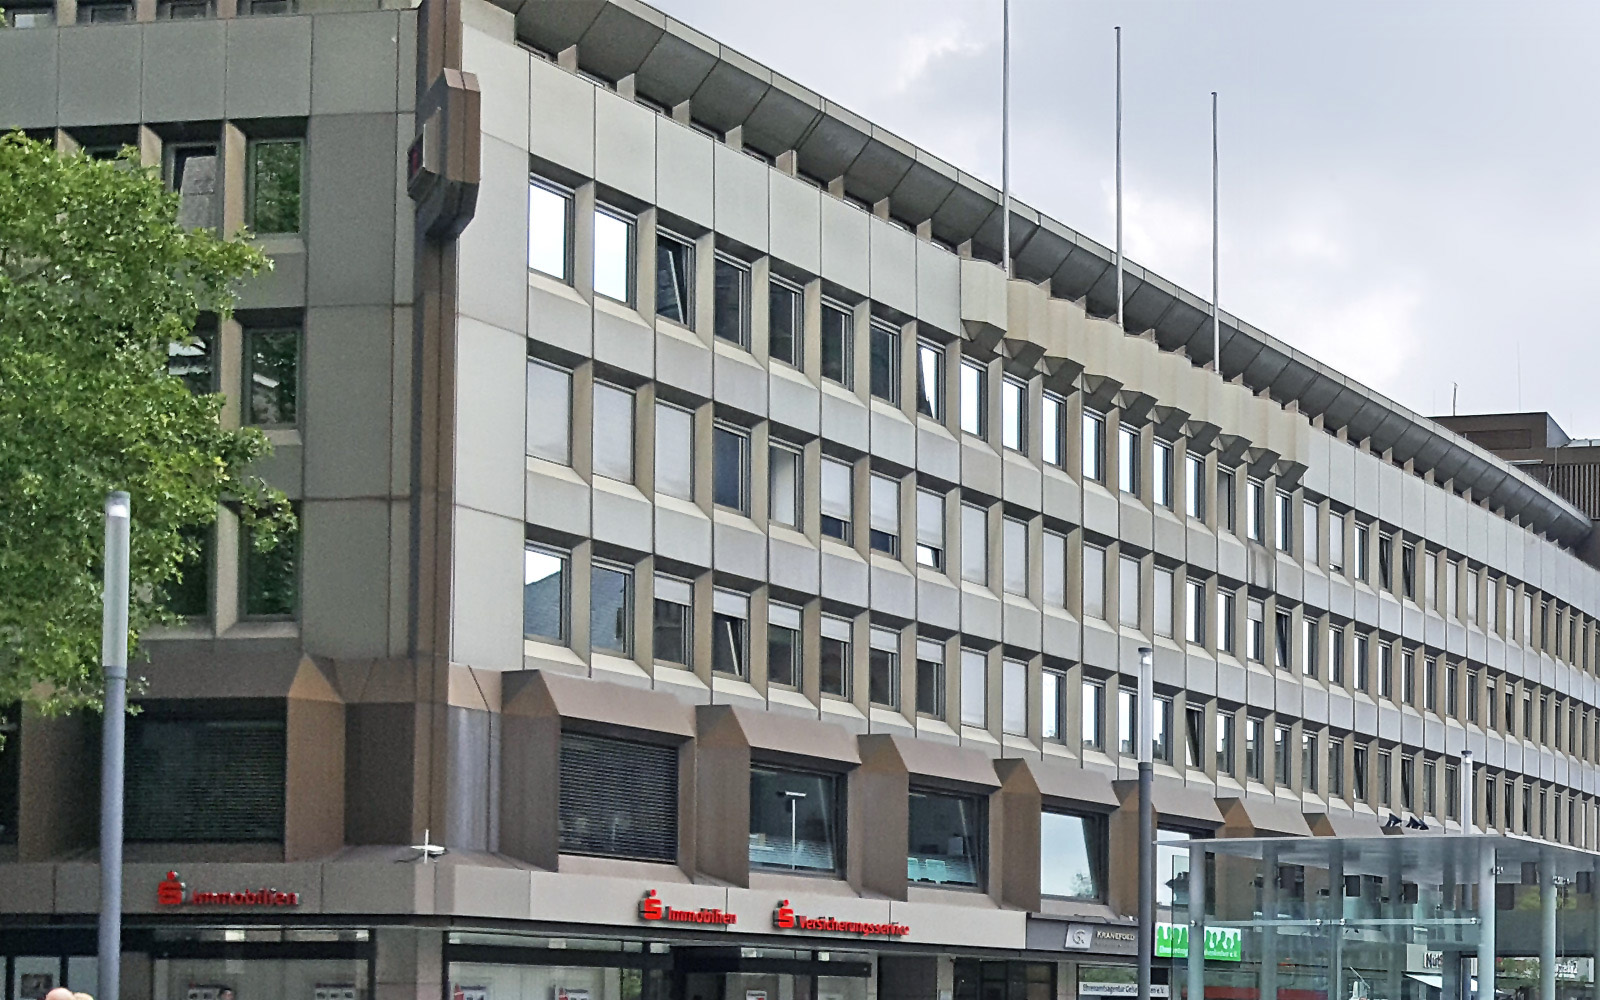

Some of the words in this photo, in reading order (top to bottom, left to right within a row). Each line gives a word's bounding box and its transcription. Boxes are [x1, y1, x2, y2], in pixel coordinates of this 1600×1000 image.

[192, 886, 299, 905] Immobilien
[667, 905, 737, 925] Immobilien
[797, 914, 910, 937] Versicherungsservice
